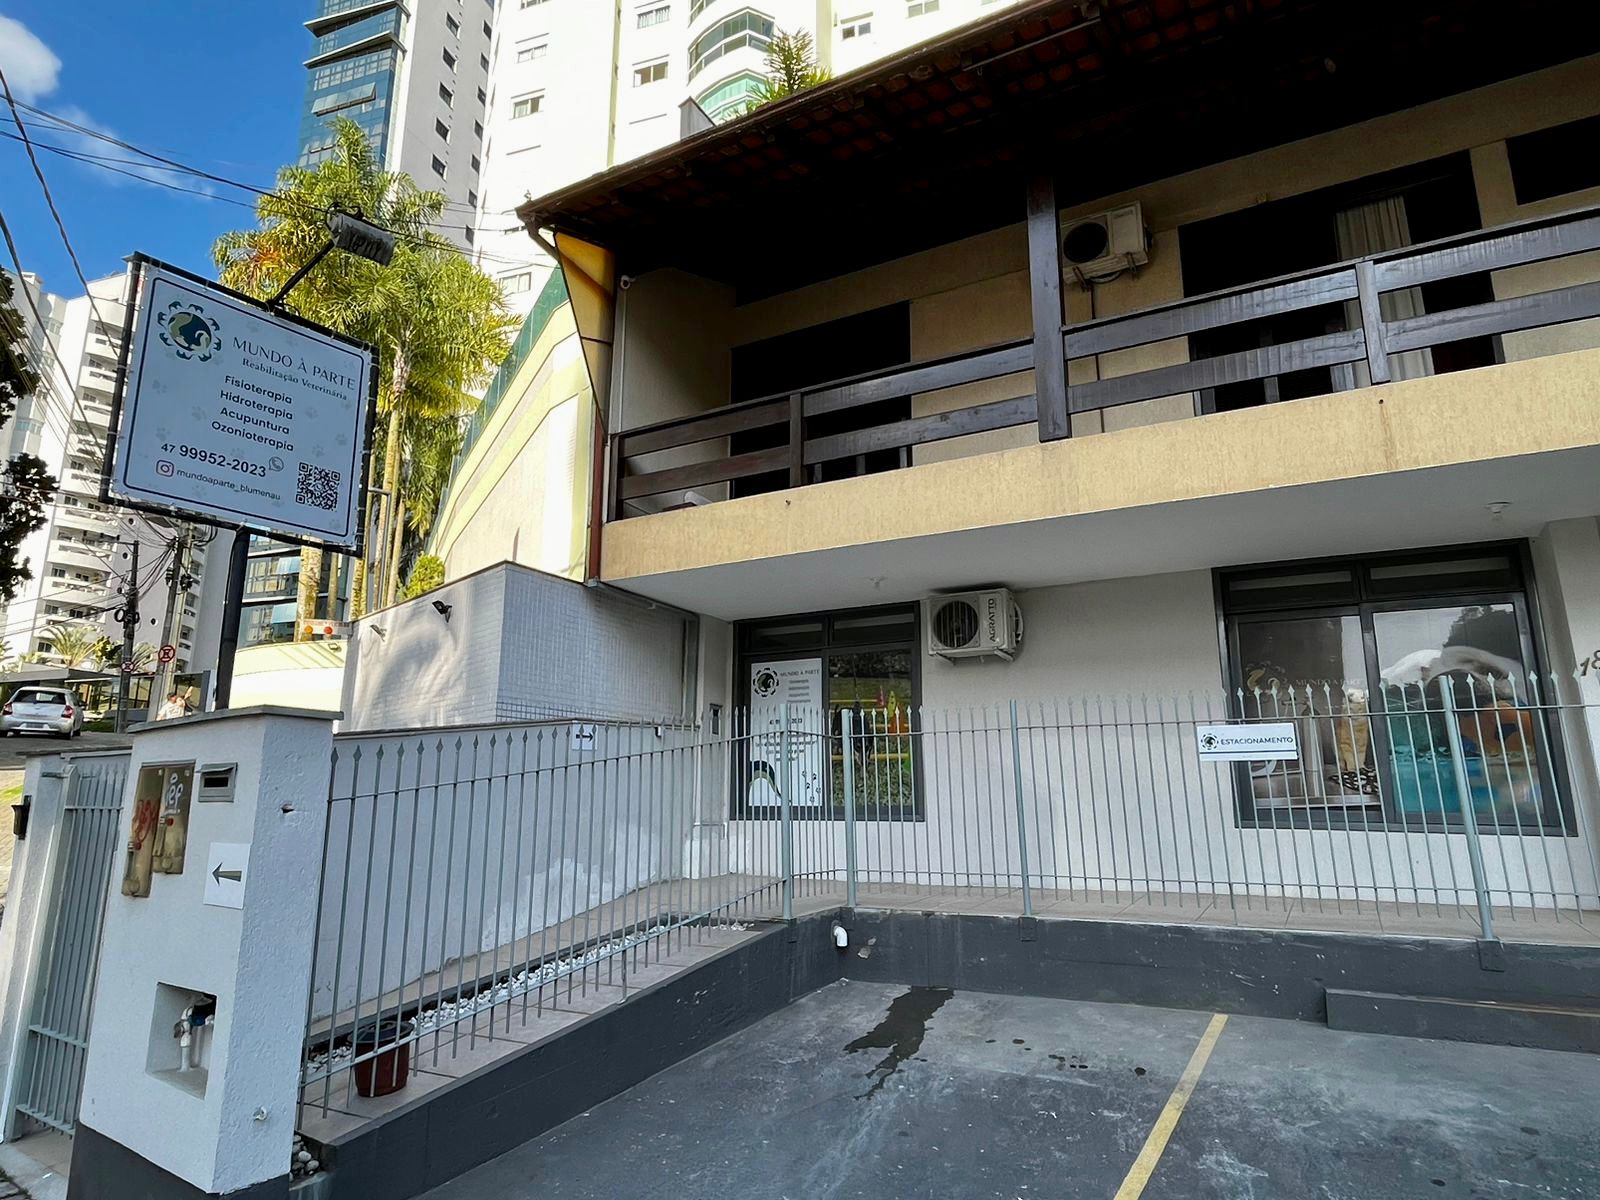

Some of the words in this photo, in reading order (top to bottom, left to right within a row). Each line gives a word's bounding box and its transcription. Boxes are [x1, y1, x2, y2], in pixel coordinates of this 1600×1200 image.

[232, 336, 293, 368] MUNDO
[297, 357, 308, 374] À
[312, 365, 356, 391] PARTE
[242, 357, 299, 384] Reabilitação
[301, 378, 347, 401] Veterinária
[220, 389, 293, 420] Hidroterapia
[224, 375, 293, 404] Fisioterapia
[211, 420, 294, 452] Ozonioterapia
[219, 407, 290, 435] Acupuntura
[160, 443, 176, 453] 47
[179, 444, 267, 478] 99952-2023
[176, 469, 281, 501] mundoaparte_blumenau
[988, 598, 996, 643] AGRATTO
[1220, 736, 1294, 746] ESTACIONAMENTO
